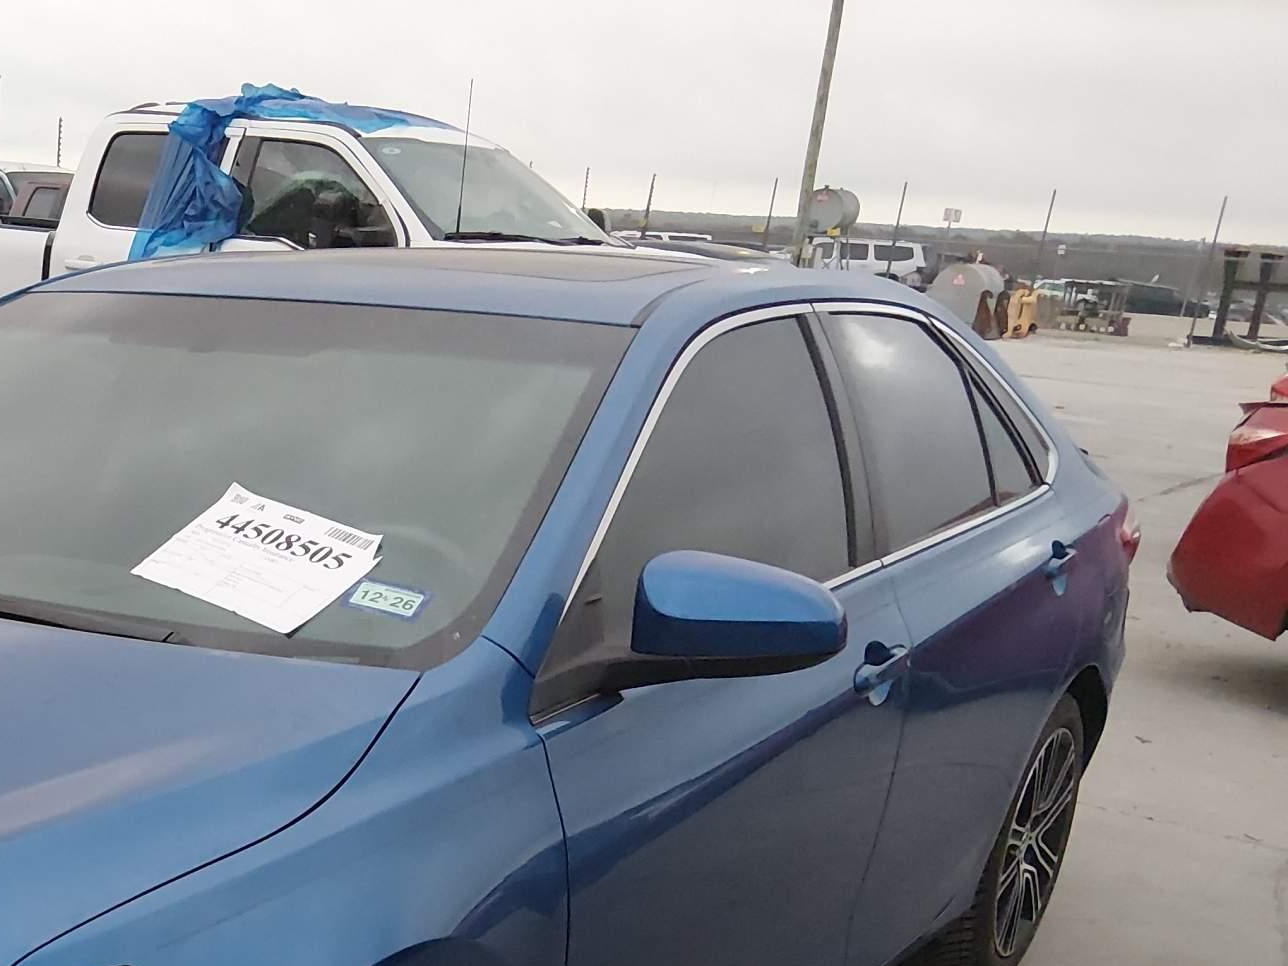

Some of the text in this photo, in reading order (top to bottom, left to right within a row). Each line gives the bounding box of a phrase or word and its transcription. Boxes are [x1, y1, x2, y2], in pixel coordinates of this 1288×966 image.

[215, 513, 353, 570] 44508505
[361, 590, 384, 604] 12
[389, 596, 416, 611] 26
